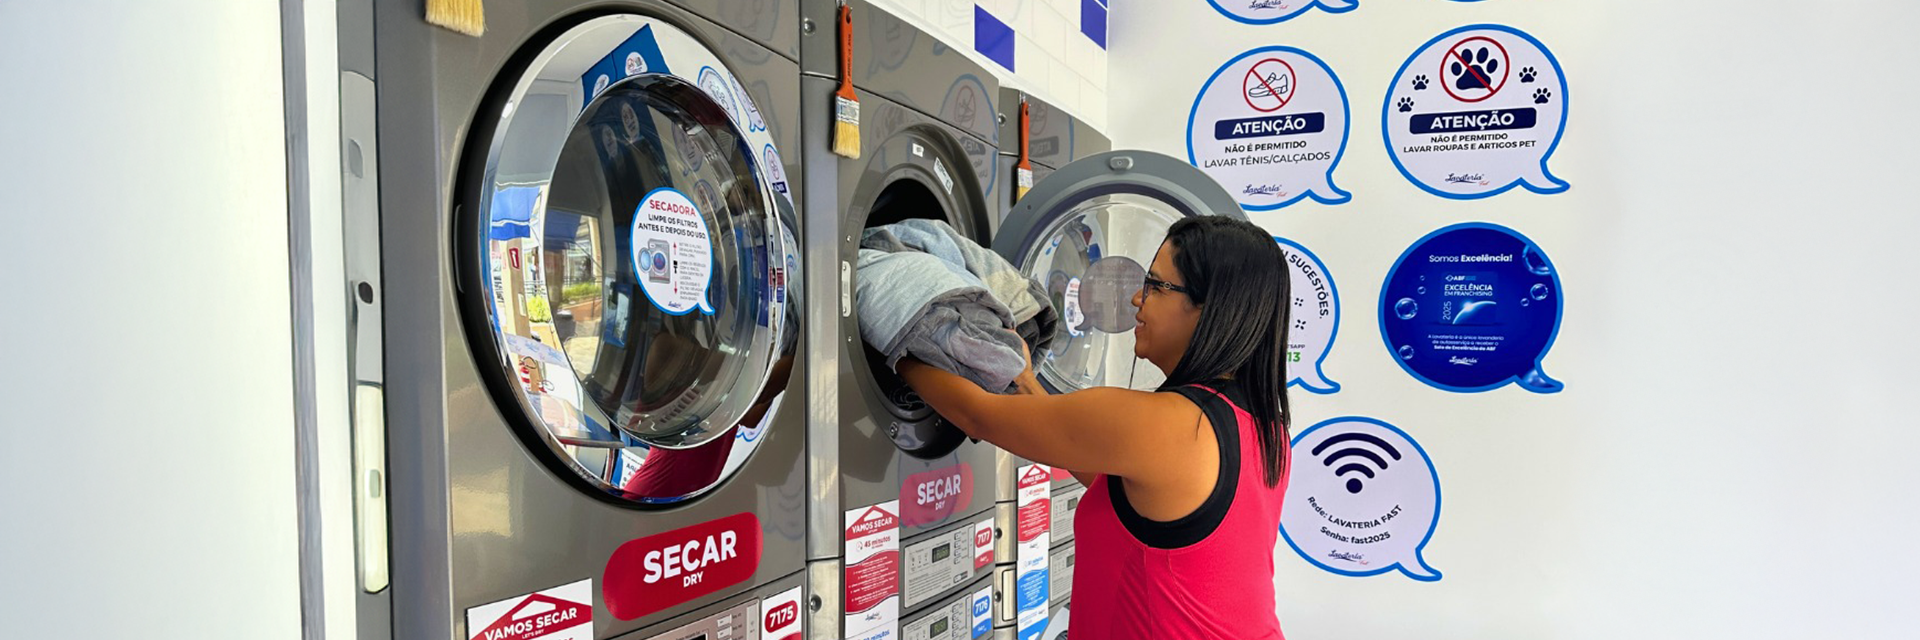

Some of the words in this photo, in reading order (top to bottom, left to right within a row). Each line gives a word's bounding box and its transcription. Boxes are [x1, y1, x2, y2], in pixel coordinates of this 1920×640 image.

[1232, 116, 1306, 135] ATENÇÃO
[1430, 111, 1514, 130] ATENÇÃO
[1225, 143, 1245, 153] NÃO
[1247, 143, 1253, 152] É
[1255, 140, 1307, 151] PERMITIDO
[1403, 145, 1431, 153] LAVAR
[1433, 144, 1469, 152] ROUPAS
[1478, 141, 1517, 149] ARTIGOS
[1519, 140, 1536, 148] PET
[1431, 135, 1449, 143] NÃO
[1452, 134, 1457, 142] É
[1459, 133, 1508, 142] PERMITIDO
[1204, 159, 1237, 168] LAVAR
[1240, 151, 1331, 166] TÊNIS/CALÇADOS
[649, 199, 696, 217] SECADORA
[638, 223, 660, 232] ANTES
[660, 225, 665, 233] E
[666, 226, 686, 236] DEPOIS
[687, 230, 695, 238] DO
[648, 214, 667, 224] LIMPE
[676, 218, 698, 229] FILTROS
[1461, 254, 1513, 262] Excelência!
[1289, 254, 1329, 319] SUGESTÕES.
[1444, 283, 1493, 291] EXCELÊNCIA
[1443, 301, 1452, 320] 2025
[917, 474, 961, 505] SECAR
[935, 500, 945, 511] DRY
[1307, 496, 1327, 518] Rede:
[1328, 515, 1380, 529] LAVATERIA
[1381, 504, 1402, 523] FAST
[852, 521, 873, 534] VAMOS
[874, 516, 893, 528] SECAR
[977, 530, 990, 545] 7177
[1320, 526, 1349, 544] Senha:
[1351, 531, 1391, 544] fast2025
[643, 530, 737, 584] SECAR
[683, 571, 704, 588] DRY
[485, 620, 533, 640] VAMOS
[536, 607, 577, 628] SECAR
[769, 605, 794, 628] 7175
